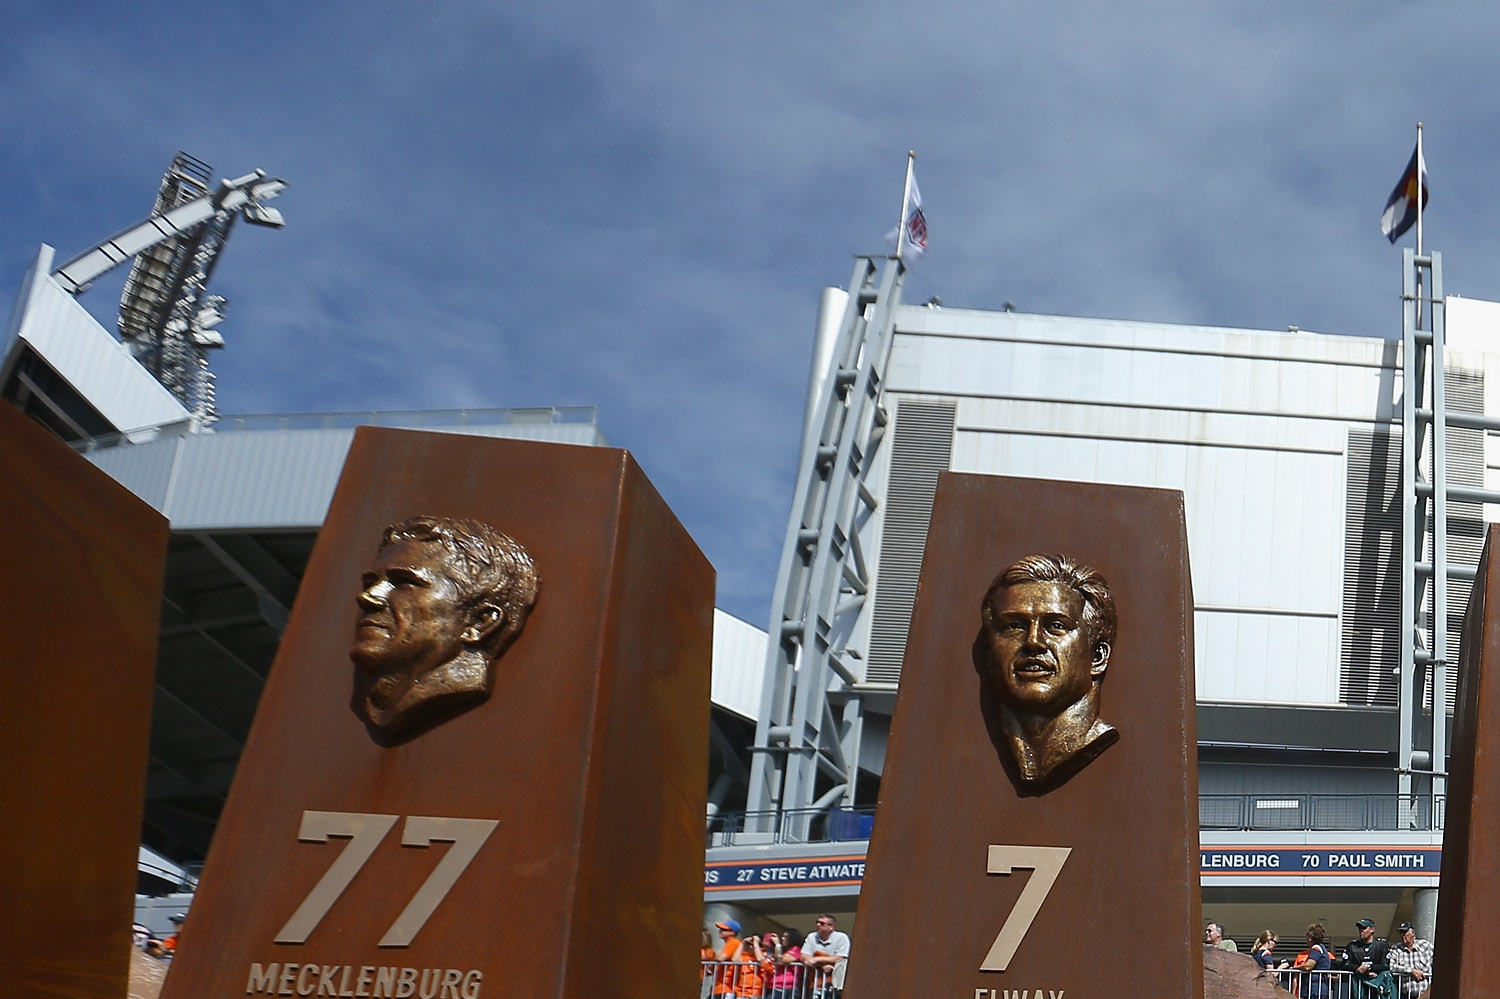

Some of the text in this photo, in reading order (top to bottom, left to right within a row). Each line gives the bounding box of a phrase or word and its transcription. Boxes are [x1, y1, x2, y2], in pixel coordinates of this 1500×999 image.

[273, 810, 500, 947] 77
[704, 862, 866, 883] IS 27 STEVE ATWATE
[1200, 854, 1424, 868] LENBURG 70 PAUL SMITH
[979, 844, 1073, 971] 7
